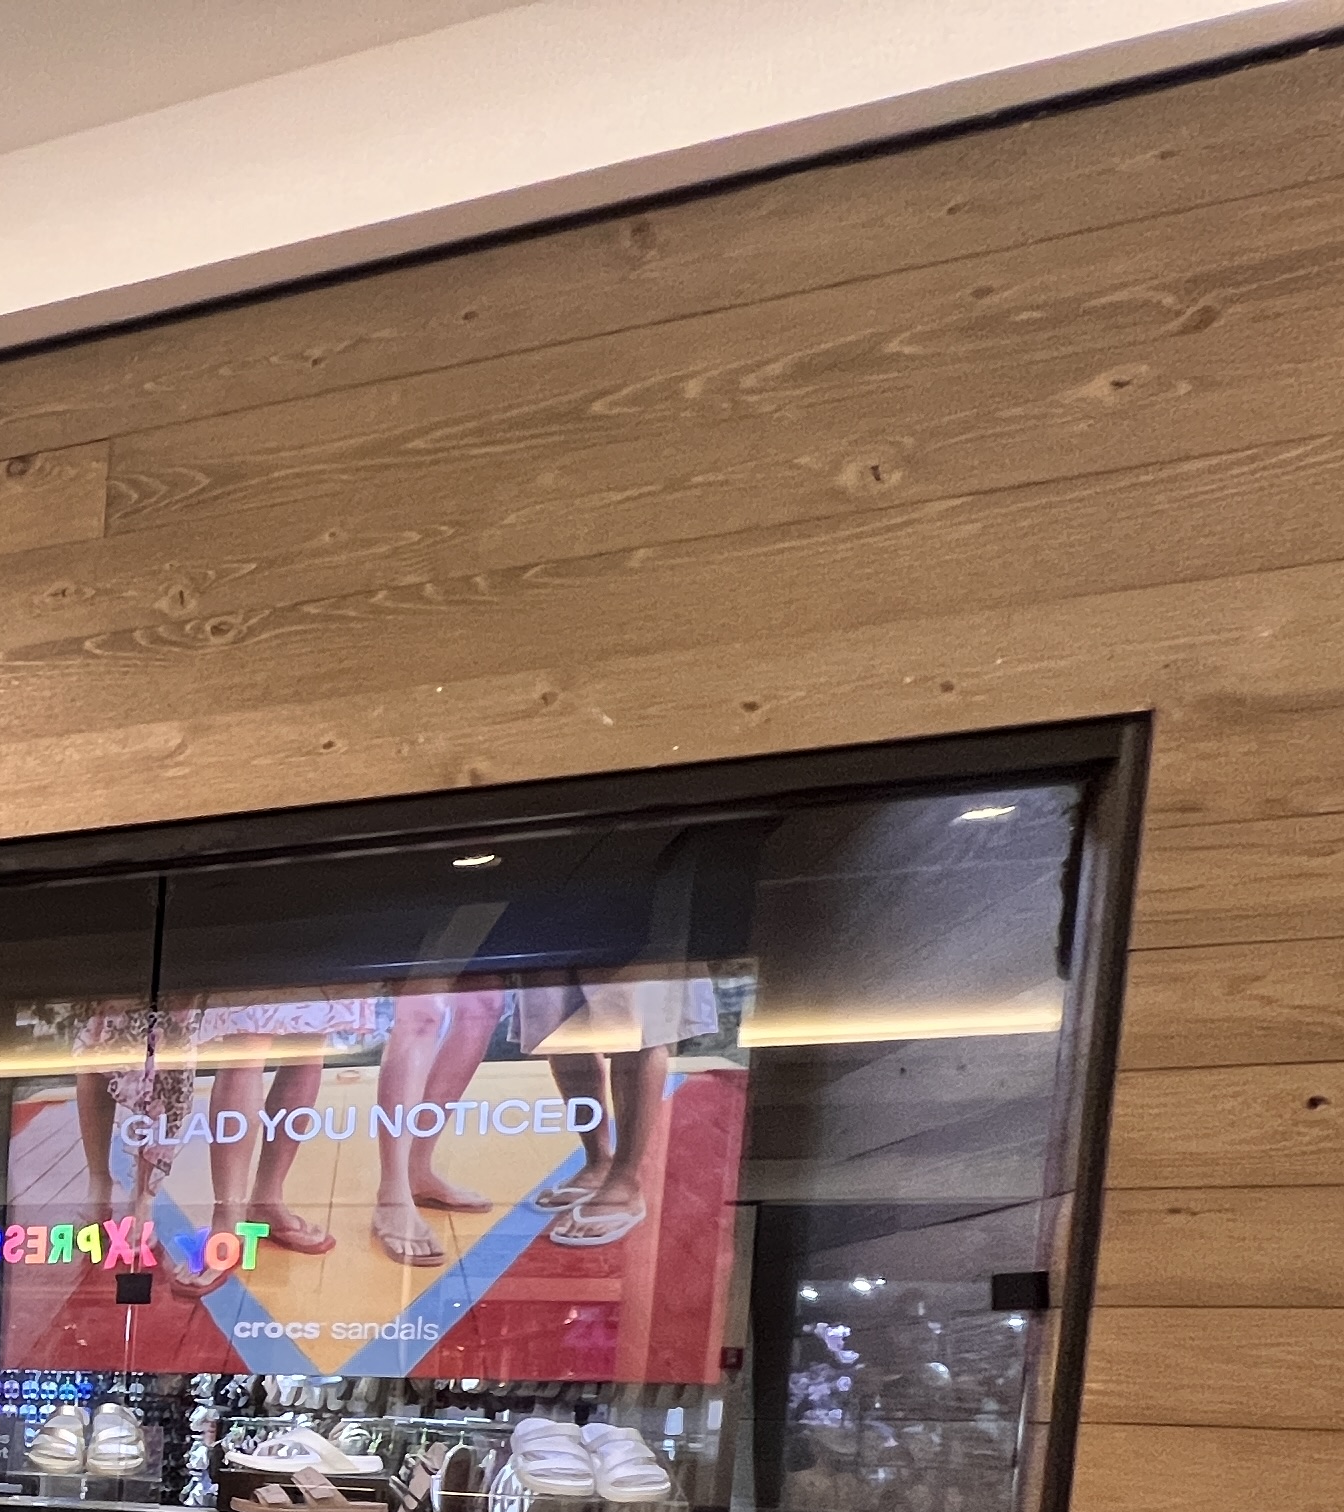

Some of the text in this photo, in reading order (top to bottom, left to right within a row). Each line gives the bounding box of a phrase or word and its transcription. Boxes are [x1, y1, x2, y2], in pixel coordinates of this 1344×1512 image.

[120, 1097, 603, 1147] GLAD YOU NOTICED
[233, 1315, 440, 1340] crocs sandals
